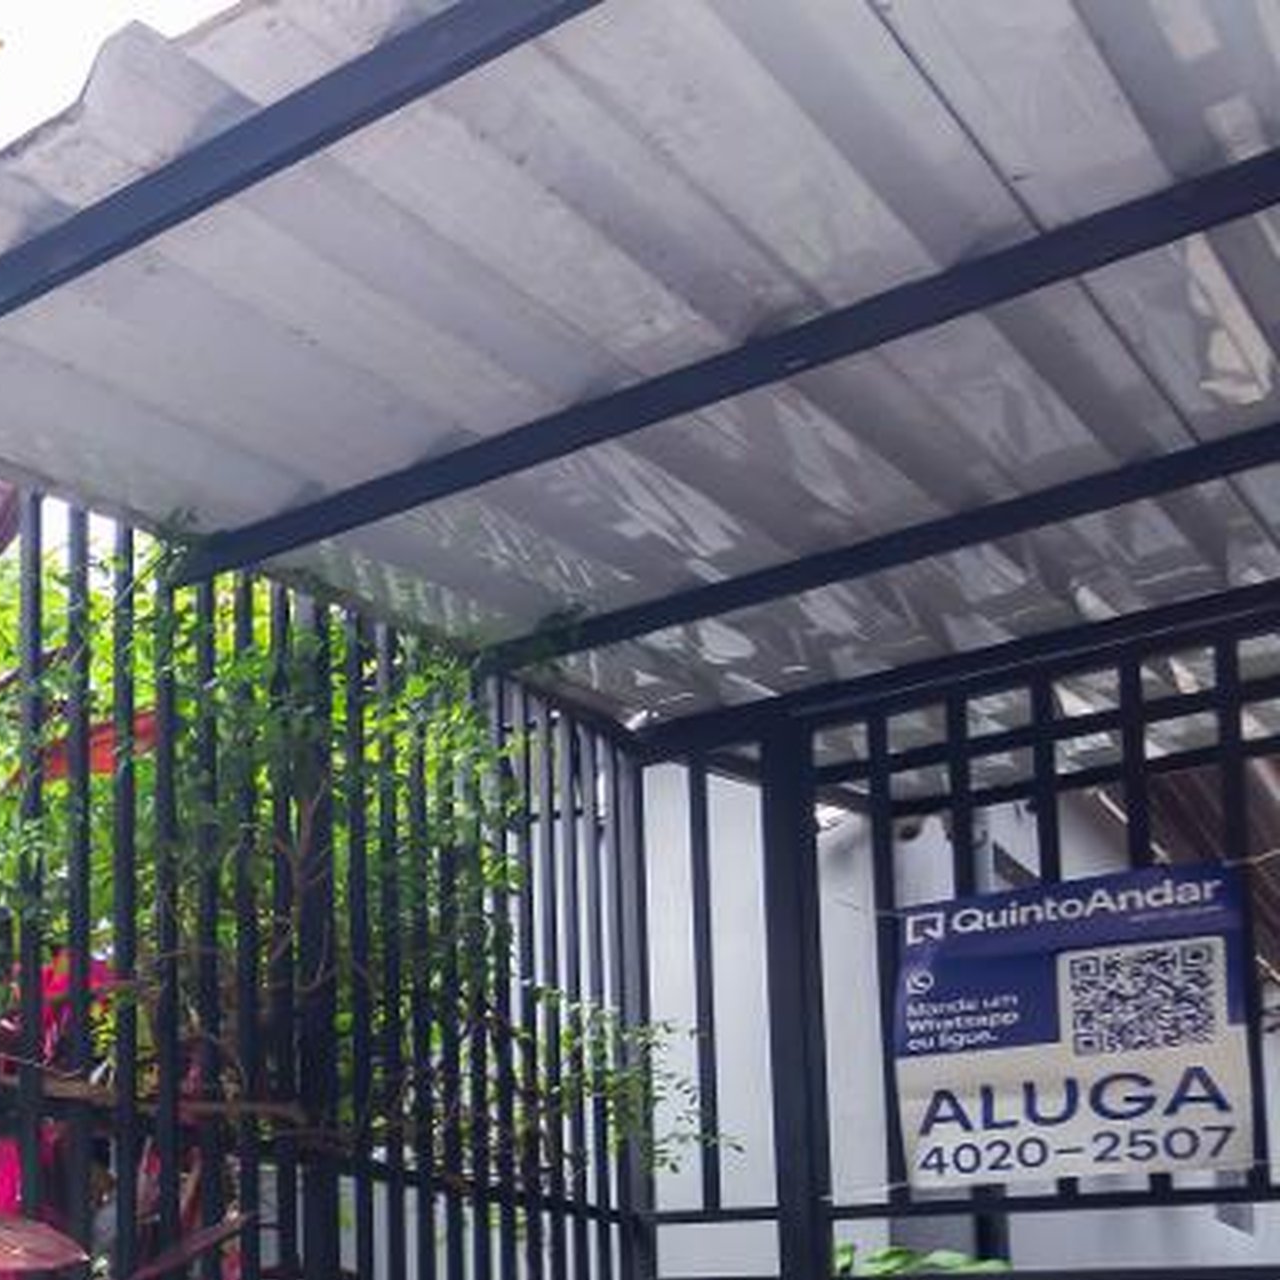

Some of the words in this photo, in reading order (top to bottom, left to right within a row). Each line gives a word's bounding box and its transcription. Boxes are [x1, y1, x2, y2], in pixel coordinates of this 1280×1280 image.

[951, 878, 1223, 934] QuintoAndar
[919, 1066, 1232, 1137] ALUGA
[919, 1125, 1236, 1176] 4020-2507
